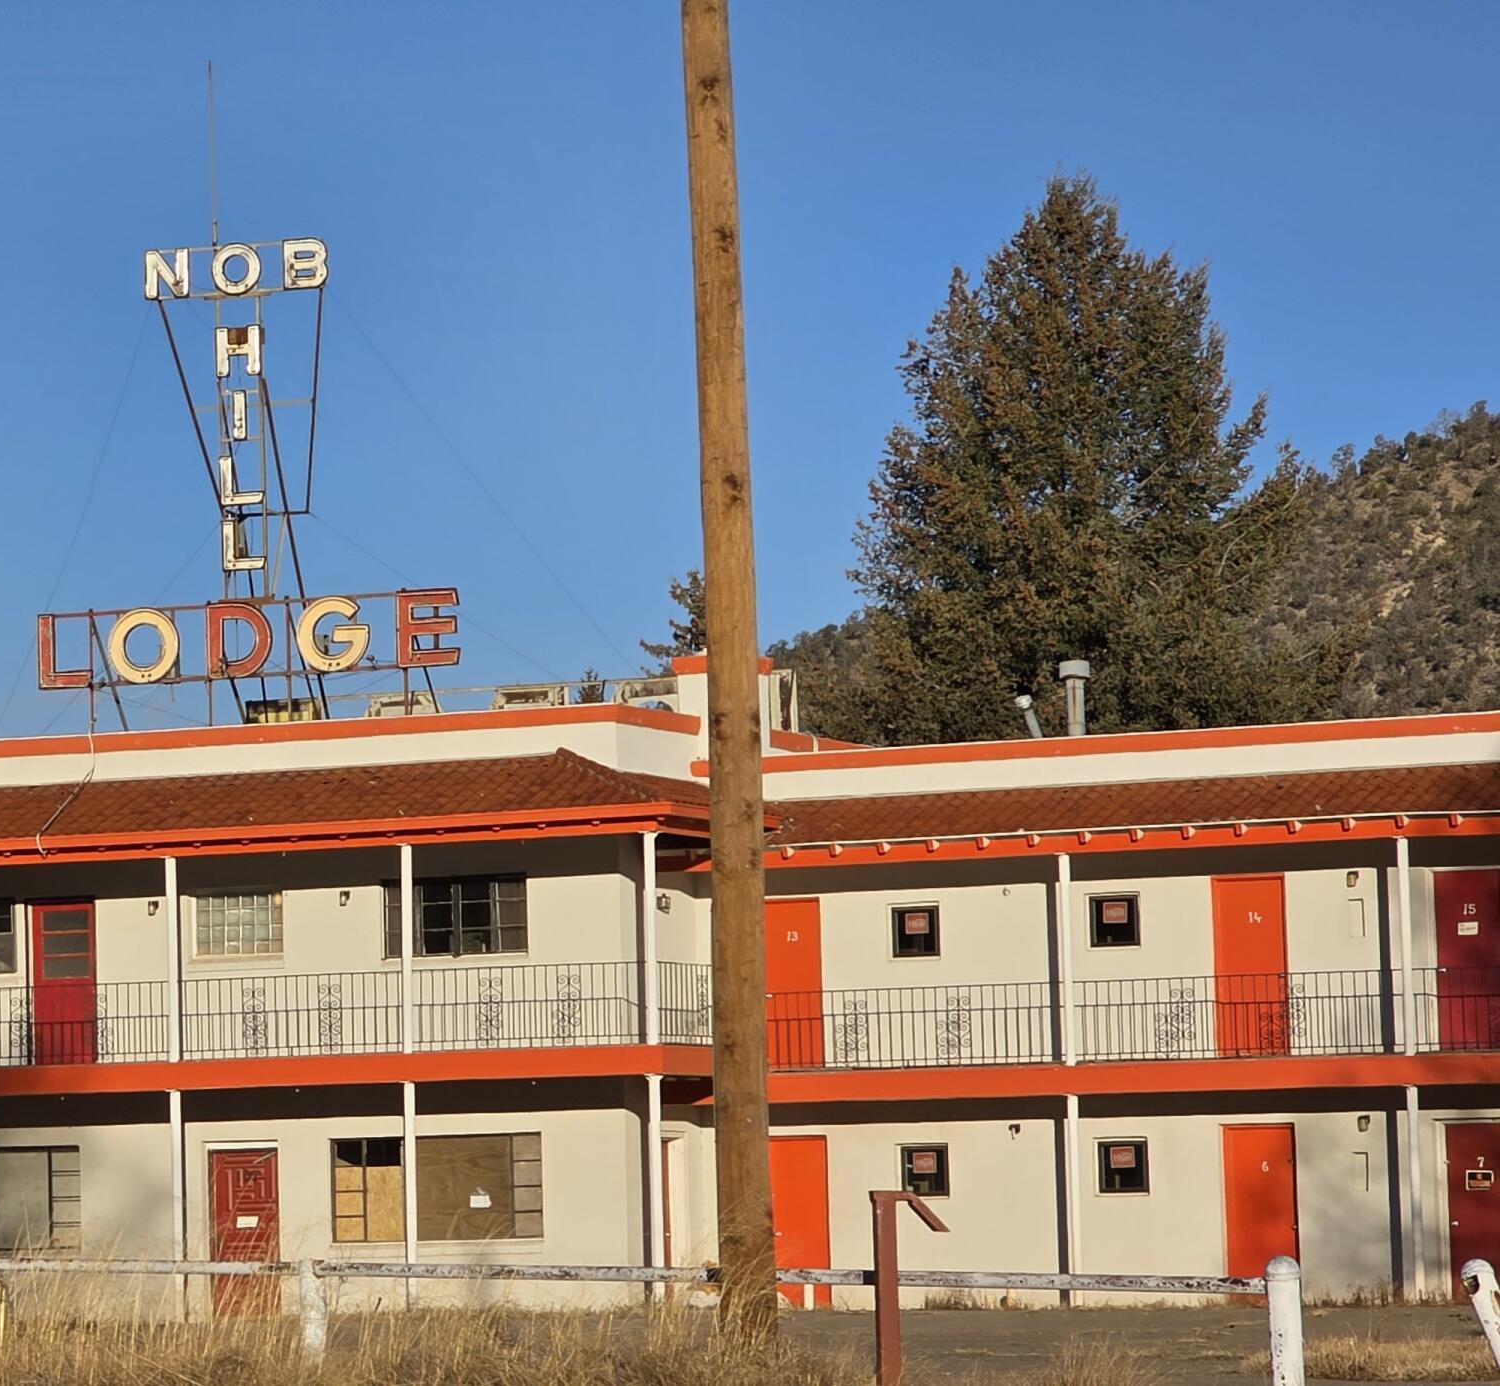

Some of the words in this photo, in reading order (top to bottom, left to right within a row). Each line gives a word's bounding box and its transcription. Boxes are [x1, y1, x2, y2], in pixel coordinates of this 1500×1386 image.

[144, 237, 328, 300] NOB
[215, 323, 266, 572] HILL
[37, 587, 460, 690] LODGE
[1463, 903, 1476, 915] 15
[1248, 912, 1262, 923] 14
[787, 931, 798, 942] 13
[1262, 1161, 1269, 1172] 6
[1477, 1157, 1484, 1168] 7
